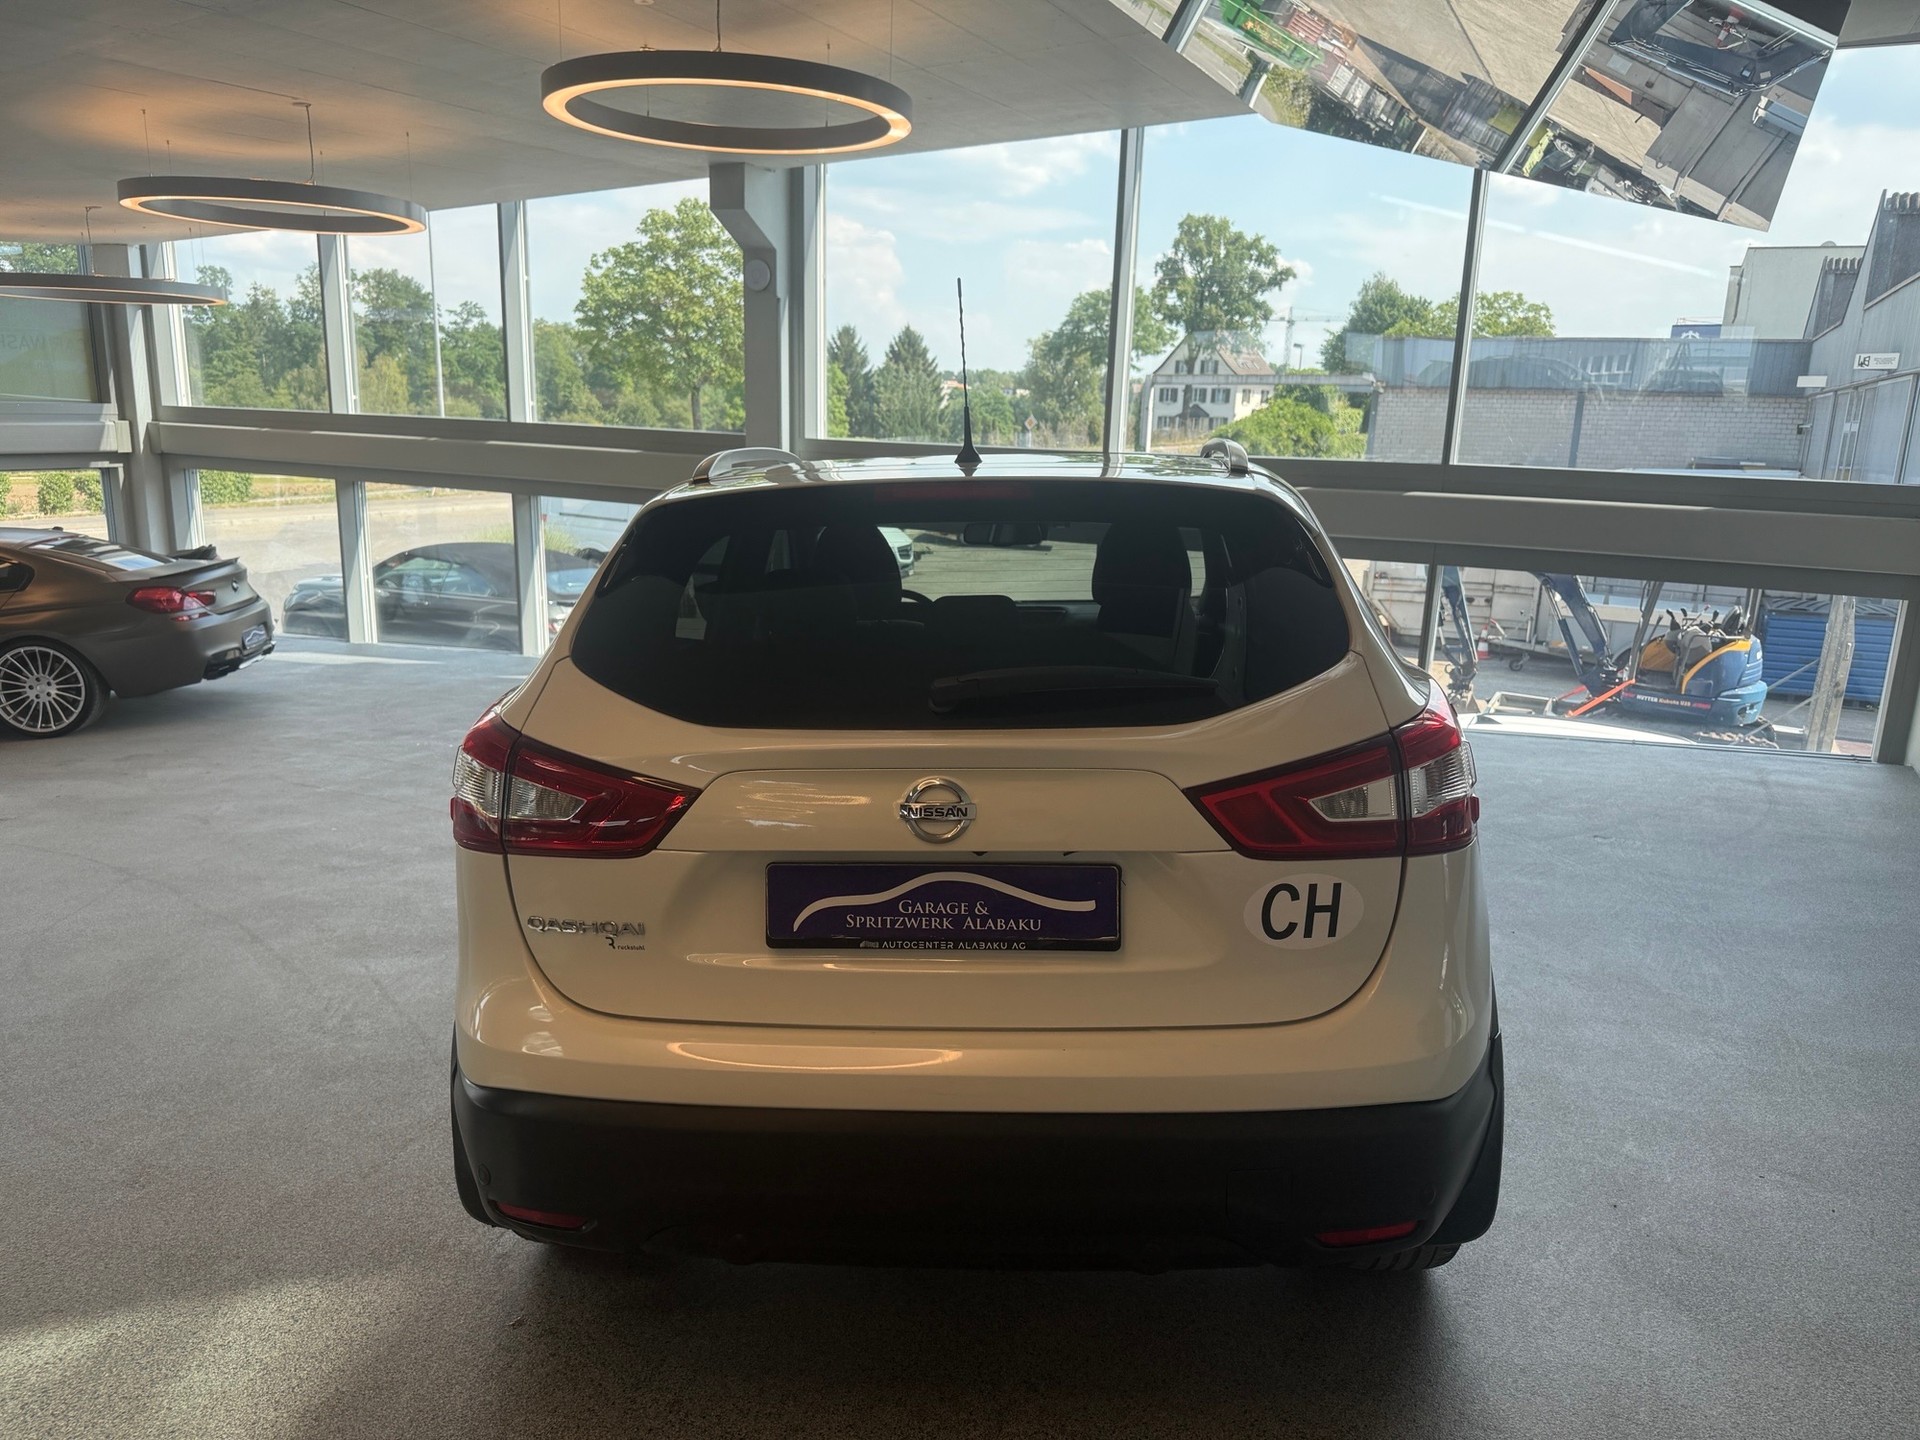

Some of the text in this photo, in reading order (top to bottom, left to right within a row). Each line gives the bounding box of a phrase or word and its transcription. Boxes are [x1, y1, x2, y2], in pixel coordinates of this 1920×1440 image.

[906, 806, 968, 818] NISSAN
[898, 899, 990, 915] GARAGE &
[1261, 882, 1342, 940] CH
[527, 915, 646, 938] QASHQAI
[846, 914, 1042, 931] SPRITZWERK ALABAKU
[882, 940, 954, 950] AUTOCENTER
[957, 941, 1007, 951] ALABAKU
[1011, 941, 1027, 951] AG
